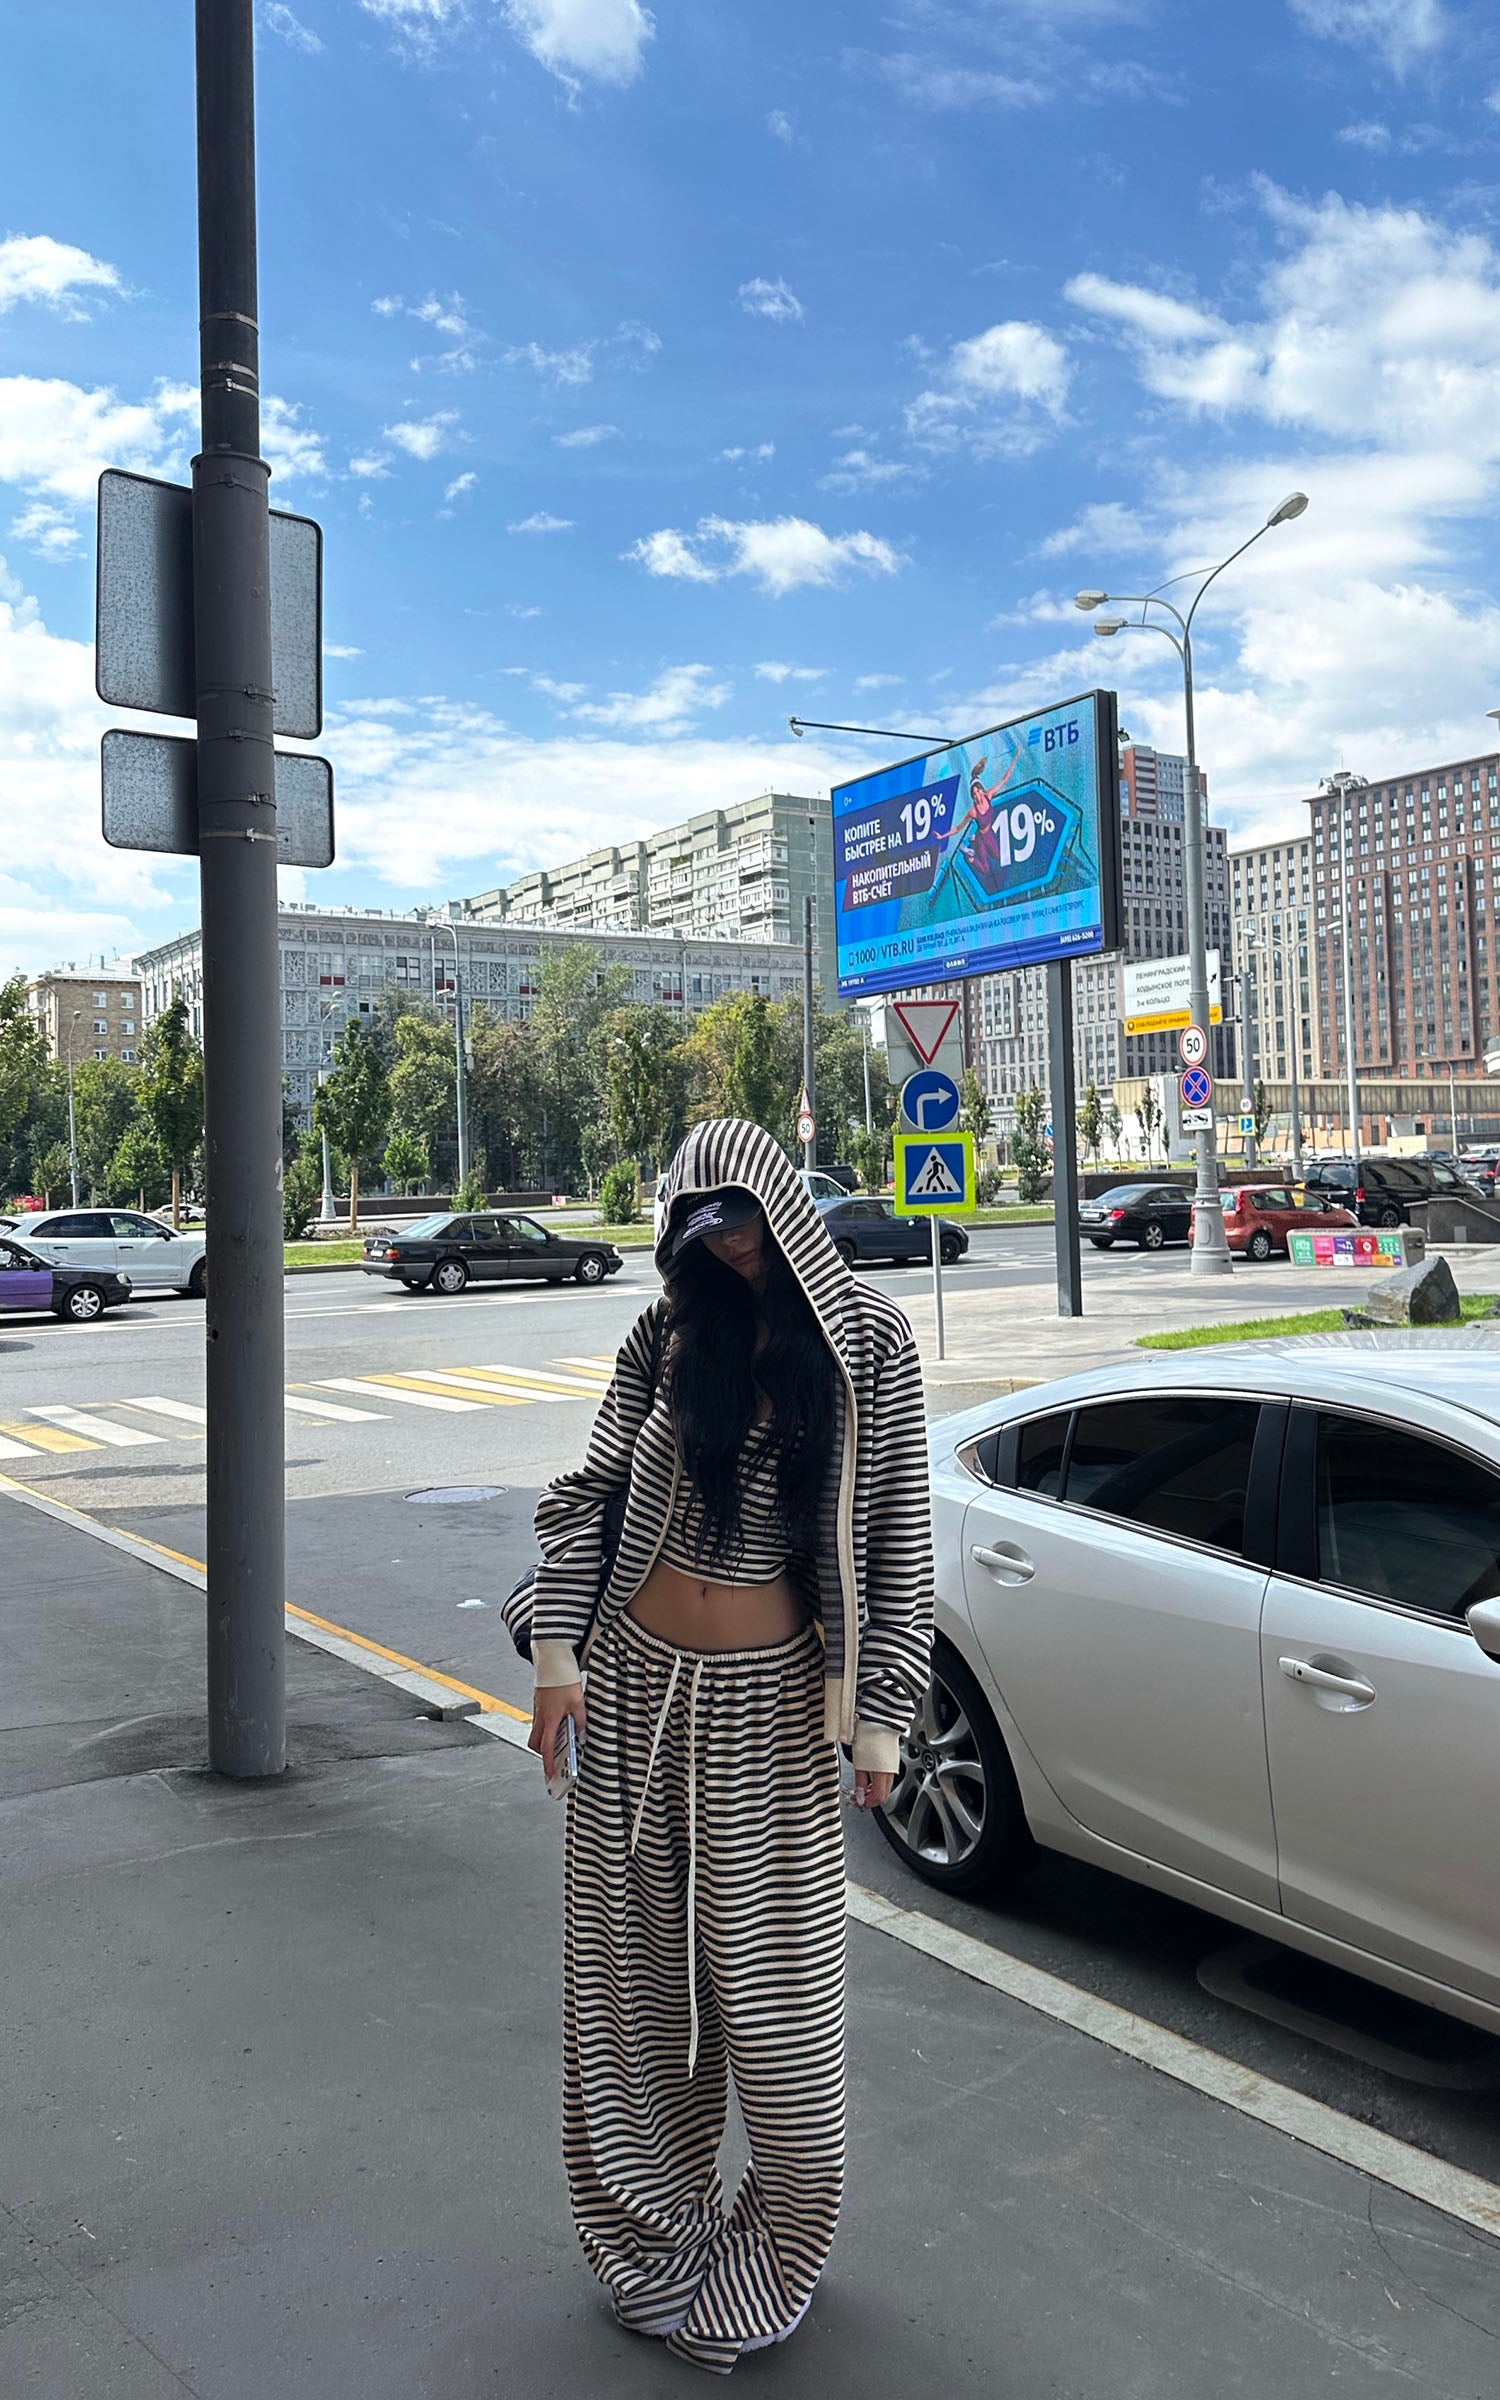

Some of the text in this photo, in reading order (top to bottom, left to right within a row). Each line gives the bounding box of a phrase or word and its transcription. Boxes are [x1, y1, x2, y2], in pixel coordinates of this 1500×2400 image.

[1044, 719, 1080, 752] ВТБ
[844, 819, 881, 843] КОПИТЕ
[845, 793, 946, 862] БЫСТРЕЕ НА 19%
[991, 803, 1055, 868] 19%
[852, 850, 931, 888] НАКОПИТЕЛЬНЫЙ
[852, 881, 893, 905] ВТБ-СЧЁТ
[855, 947, 876, 965] 1000
[881, 938, 914, 960] VTB.RU
[1135, 964, 1186, 980] ЛЕНИНГРАДСКИЙ
[1136, 978, 1190, 993] ХОДЫНСКОЕ ПОЛЕ
[1146, 995, 1171, 1006] КОЛЬЦО
[1186, 1037, 1200, 1054] 50
[801, 1123, 810, 1134] 50
